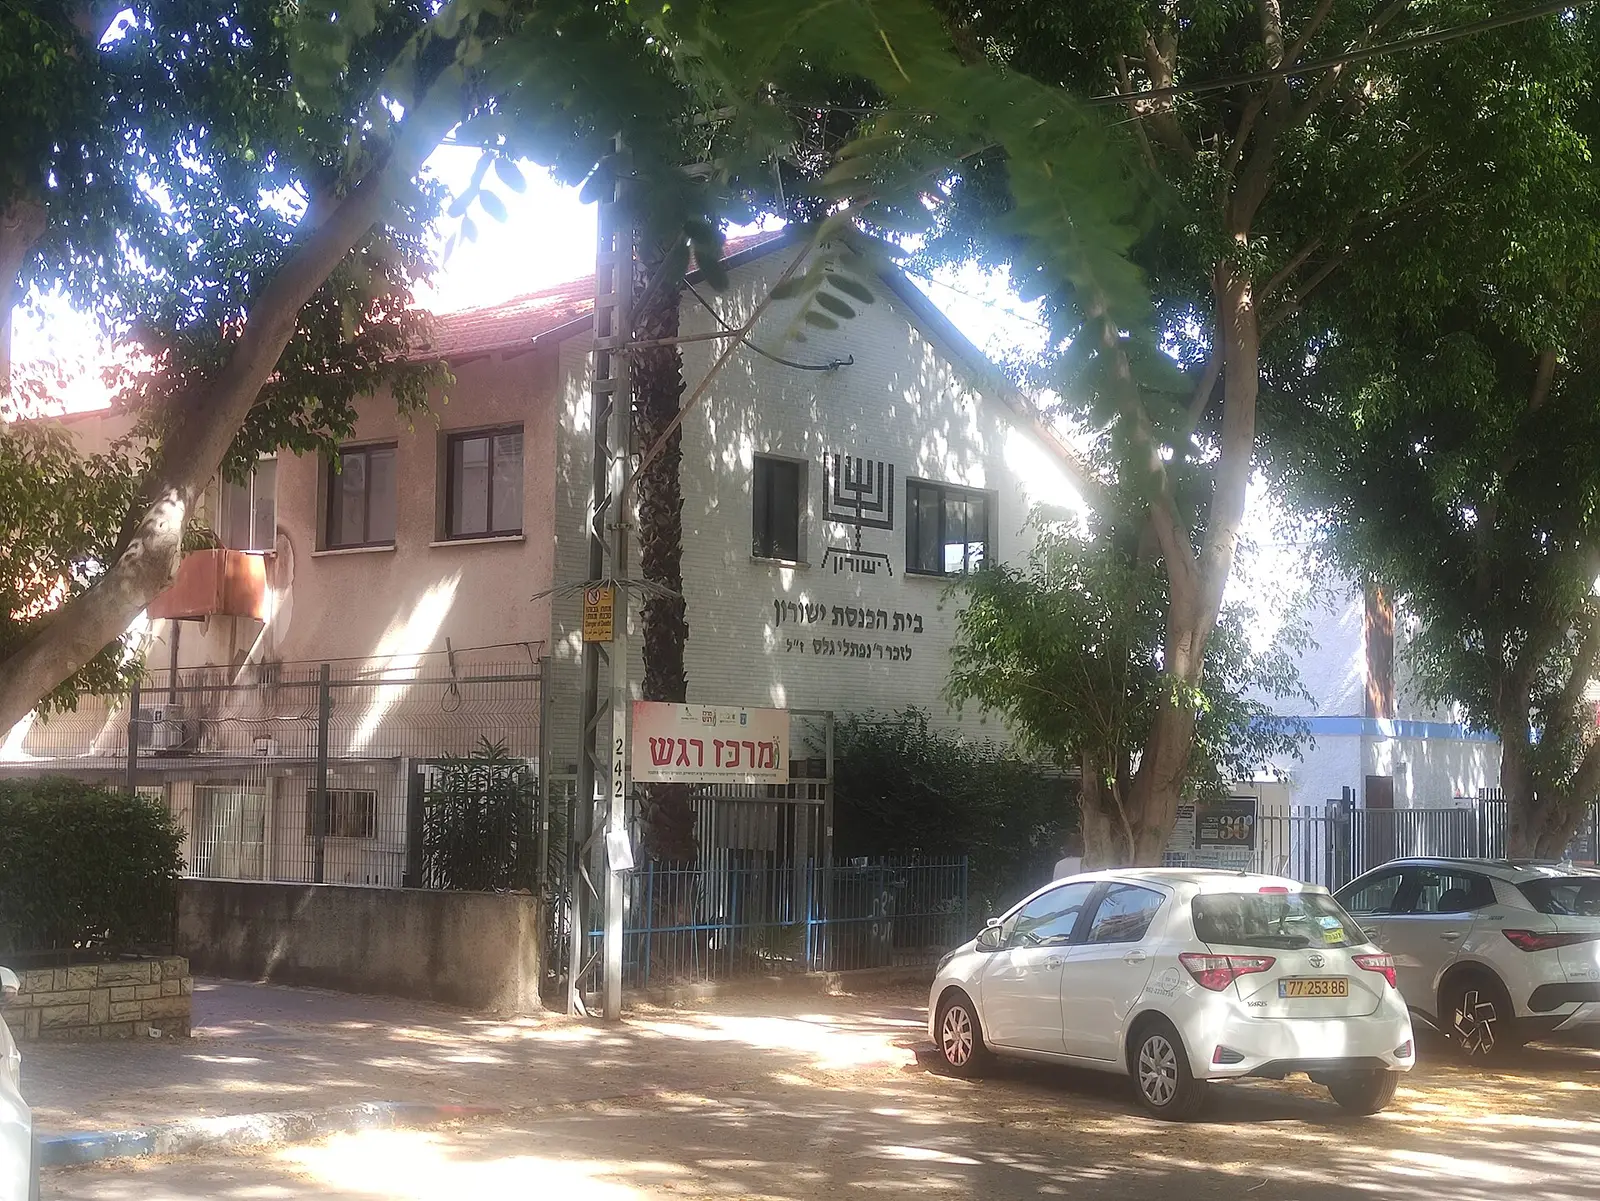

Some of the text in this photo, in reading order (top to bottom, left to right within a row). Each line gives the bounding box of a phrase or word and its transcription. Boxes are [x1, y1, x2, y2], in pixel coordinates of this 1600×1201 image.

[834, 556, 881, 574] ישורון
[774, 599, 924, 633] בית הכנסת ישורון
[886, 644, 913, 661] לזכר
[614, 738, 623, 798] 242
[649, 737, 774, 768] מרכז רגש
